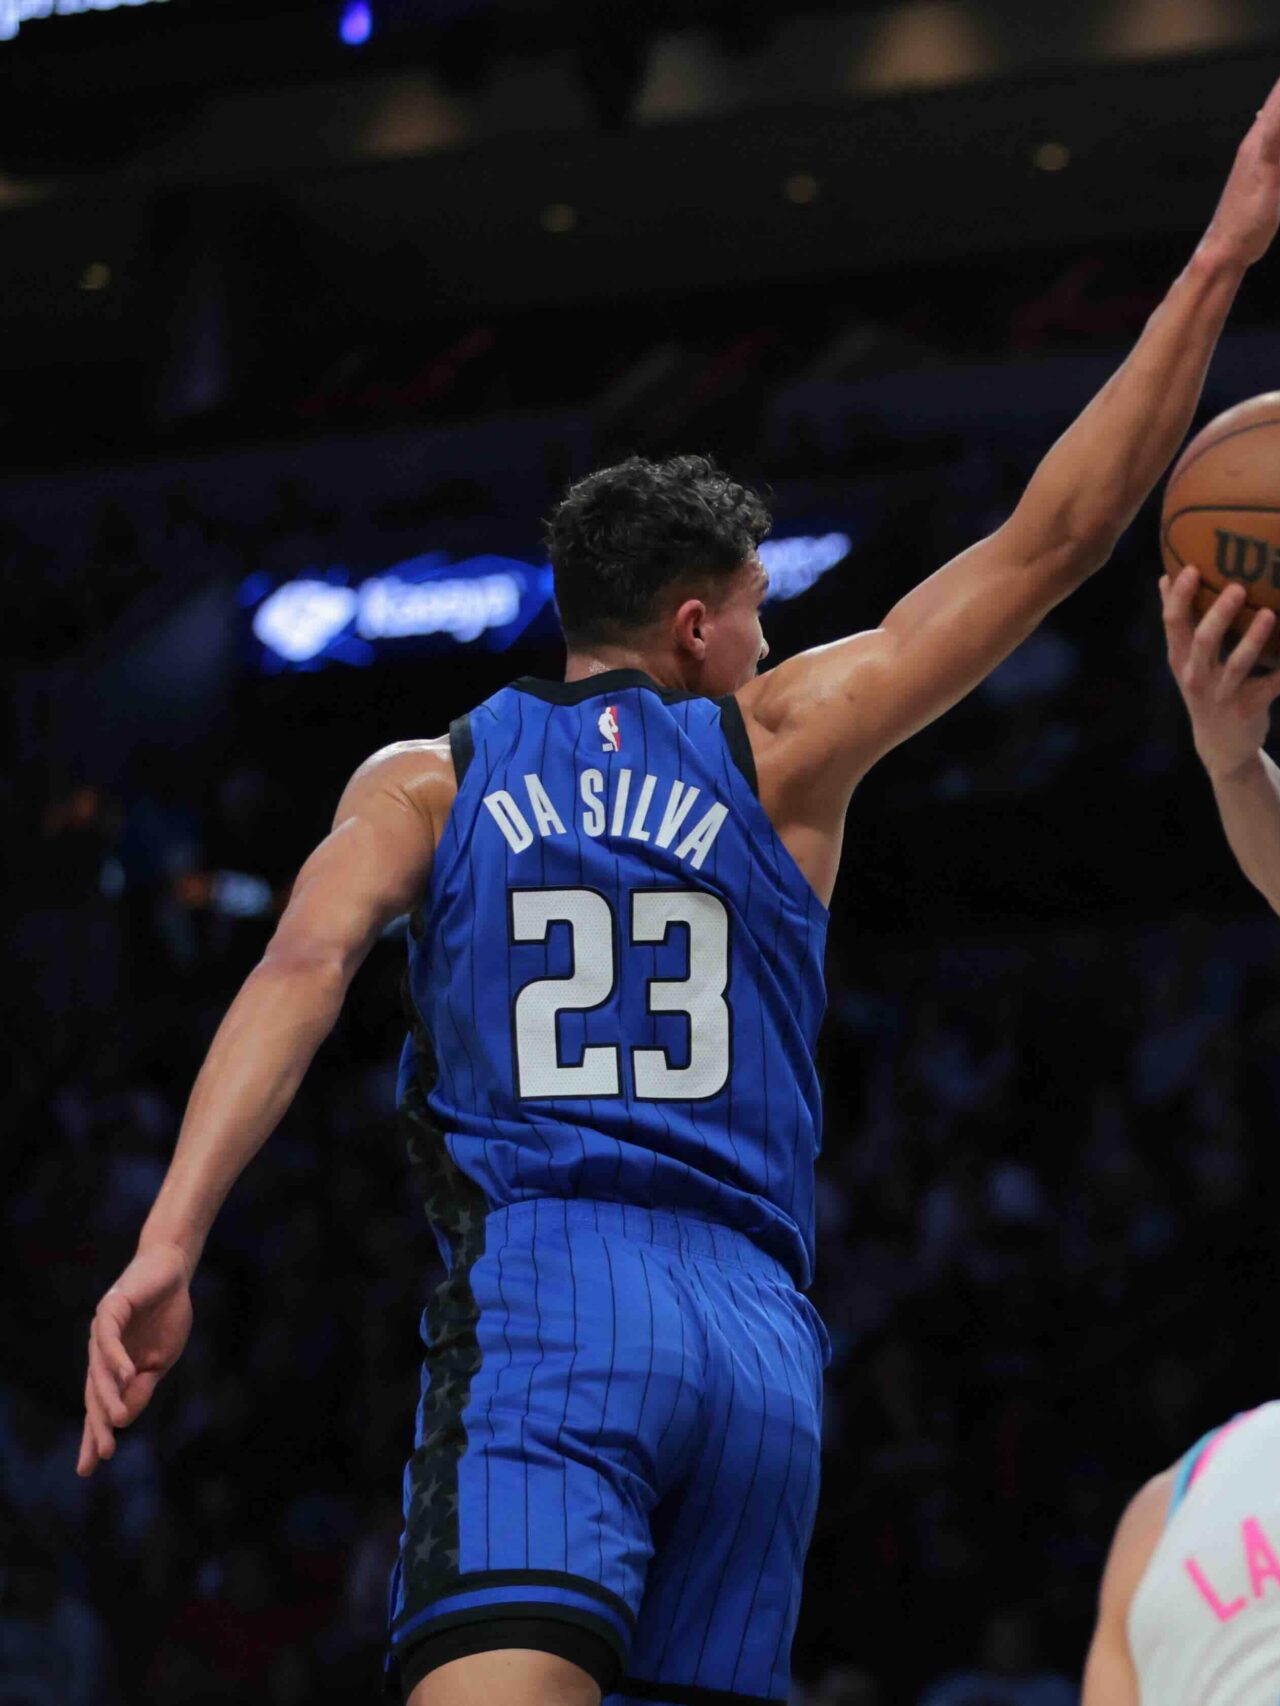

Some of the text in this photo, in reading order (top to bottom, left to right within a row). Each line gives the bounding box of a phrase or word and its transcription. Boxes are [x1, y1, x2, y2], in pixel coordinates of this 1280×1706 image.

[483, 768, 729, 870] DA SILVA
[508, 887, 733, 1102] 23
